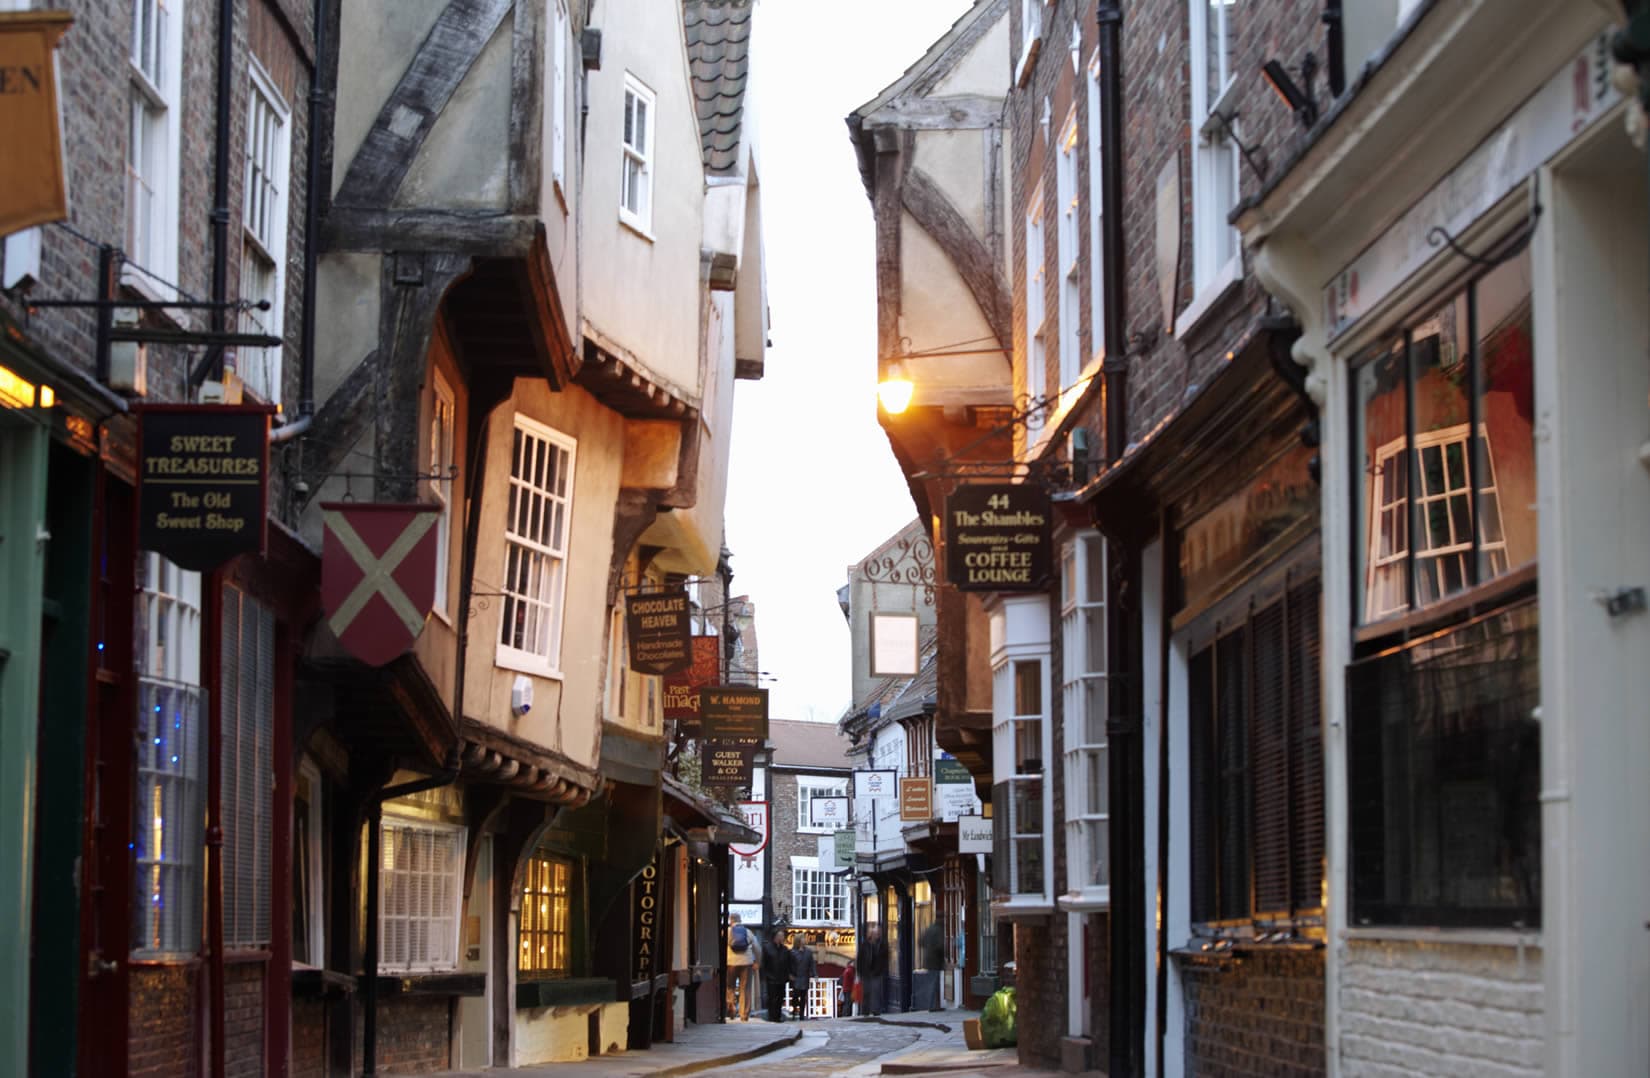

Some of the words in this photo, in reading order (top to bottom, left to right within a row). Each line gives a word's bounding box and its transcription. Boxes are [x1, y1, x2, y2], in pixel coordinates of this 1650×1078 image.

[170, 435, 236, 453] SWEET
[146, 457, 259, 475] TREASURES
[171, 491, 199, 508] The
[203, 491, 231, 508] Old
[987, 494, 1010, 510] 44
[156, 513, 201, 529] Sweet
[205, 513, 244, 532] Shop
[954, 510, 980, 527] The
[981, 510, 1045, 527] Shambles
[965, 552, 1033, 567] COFFEE
[968, 569, 1030, 582] LOUNGE
[631, 598, 685, 615] CHOCOLATE
[640, 614, 678, 629] HEAVEN
[636, 639, 684, 650] Handmade
[669, 685, 690, 694] Past
[722, 695, 761, 705] HAMOND
[714, 751, 741, 759] GUEST
[712, 759, 744, 767] WALKER
